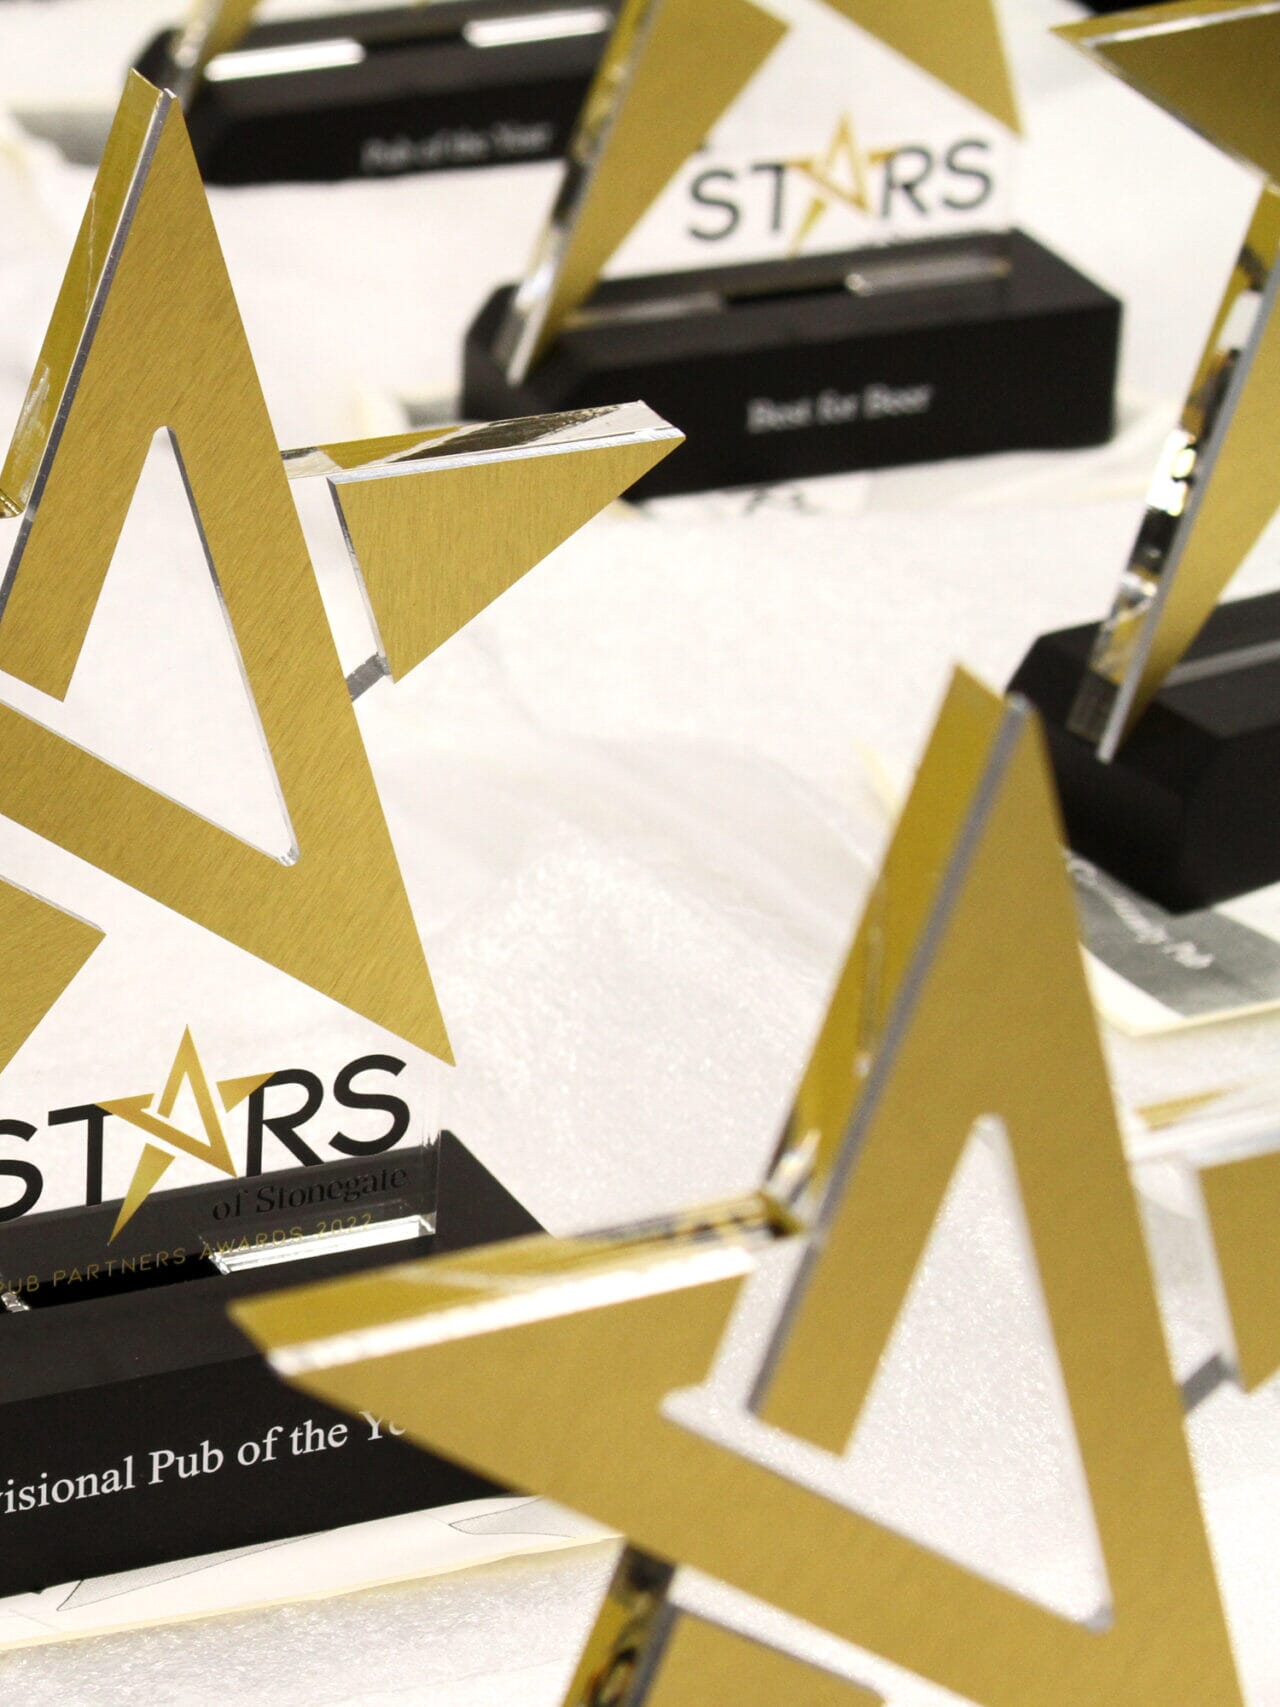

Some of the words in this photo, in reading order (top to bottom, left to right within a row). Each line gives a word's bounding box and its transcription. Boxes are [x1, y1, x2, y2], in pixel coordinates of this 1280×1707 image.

[689, 110, 994, 258] STARS
[748, 397, 813, 434] Best
[817, 389, 859, 425] for
[863, 383, 934, 419] Beer
[211, 1189, 249, 1221] of
[256, 1168, 408, 1214] Stonegate
[53, 1247, 187, 1288] PARTNERS
[199, 1226, 303, 1260] AWARDS
[316, 1213, 373, 1239] 2022
[148, 1440, 224, 1485] Pub
[237, 1425, 284, 1466] of
[290, 1419, 348, 1457] the
